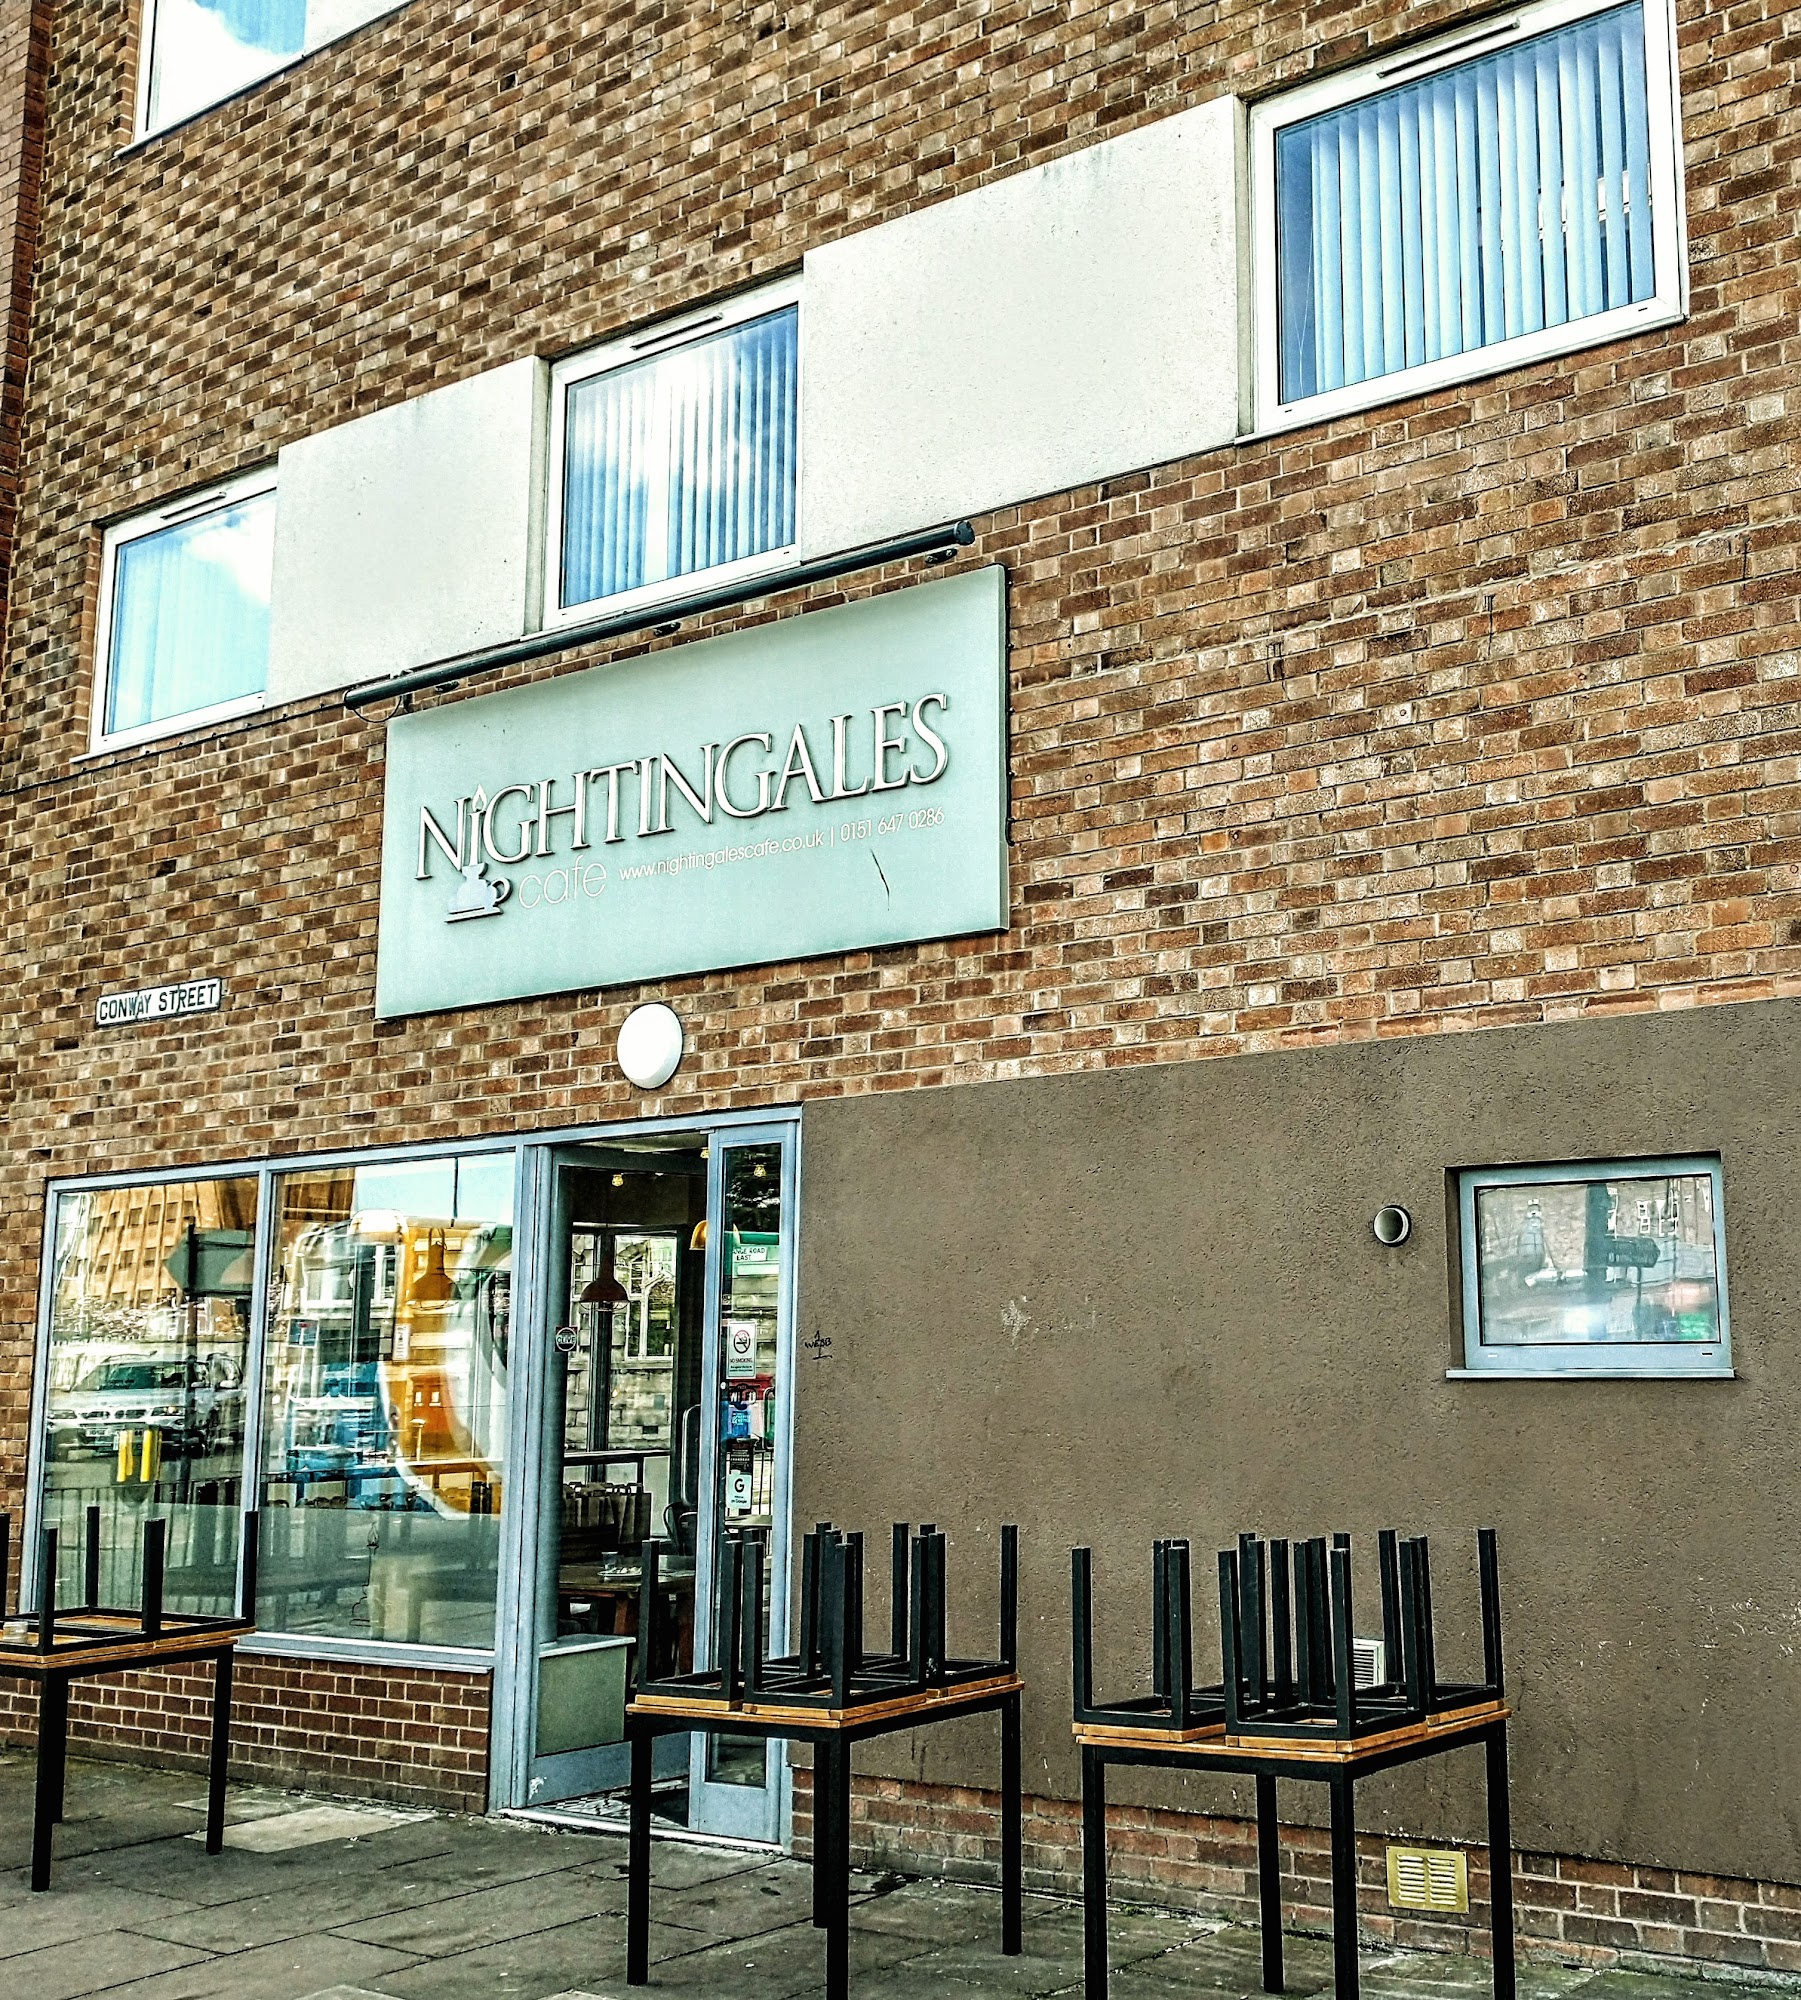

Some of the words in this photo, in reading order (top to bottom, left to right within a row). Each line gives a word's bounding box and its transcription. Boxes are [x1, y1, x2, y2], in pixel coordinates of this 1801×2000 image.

[619, 828, 825, 881] www.nightingalescafe.co.uk
[840, 818, 873, 843] 0151
[877, 813, 905, 836] 647
[907, 805, 946, 831] 0286
[518, 854, 608, 910] cafe
[99, 993, 152, 1020] CONWAY
[158, 983, 217, 1012] STREET
